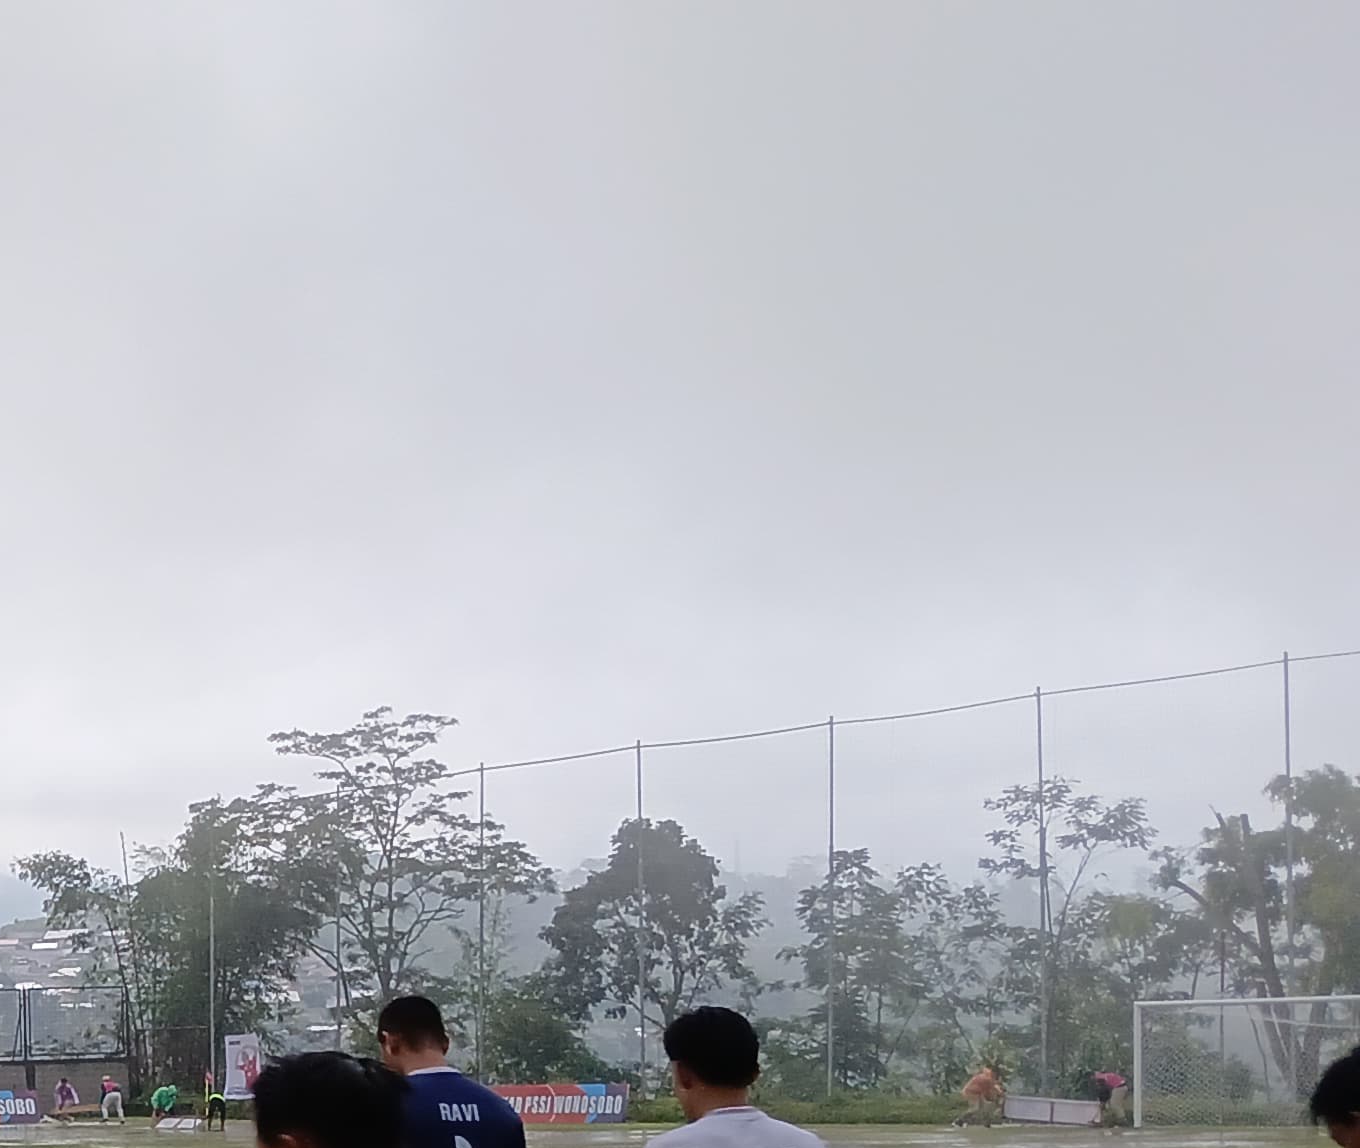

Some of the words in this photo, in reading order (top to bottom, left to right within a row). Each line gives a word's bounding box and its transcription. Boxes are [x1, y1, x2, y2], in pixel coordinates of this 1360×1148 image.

[438, 1102, 480, 1122] RAVI
[524, 1095, 551, 1114] PSSI
[553, 1094, 623, 1115] WONOSOBO
